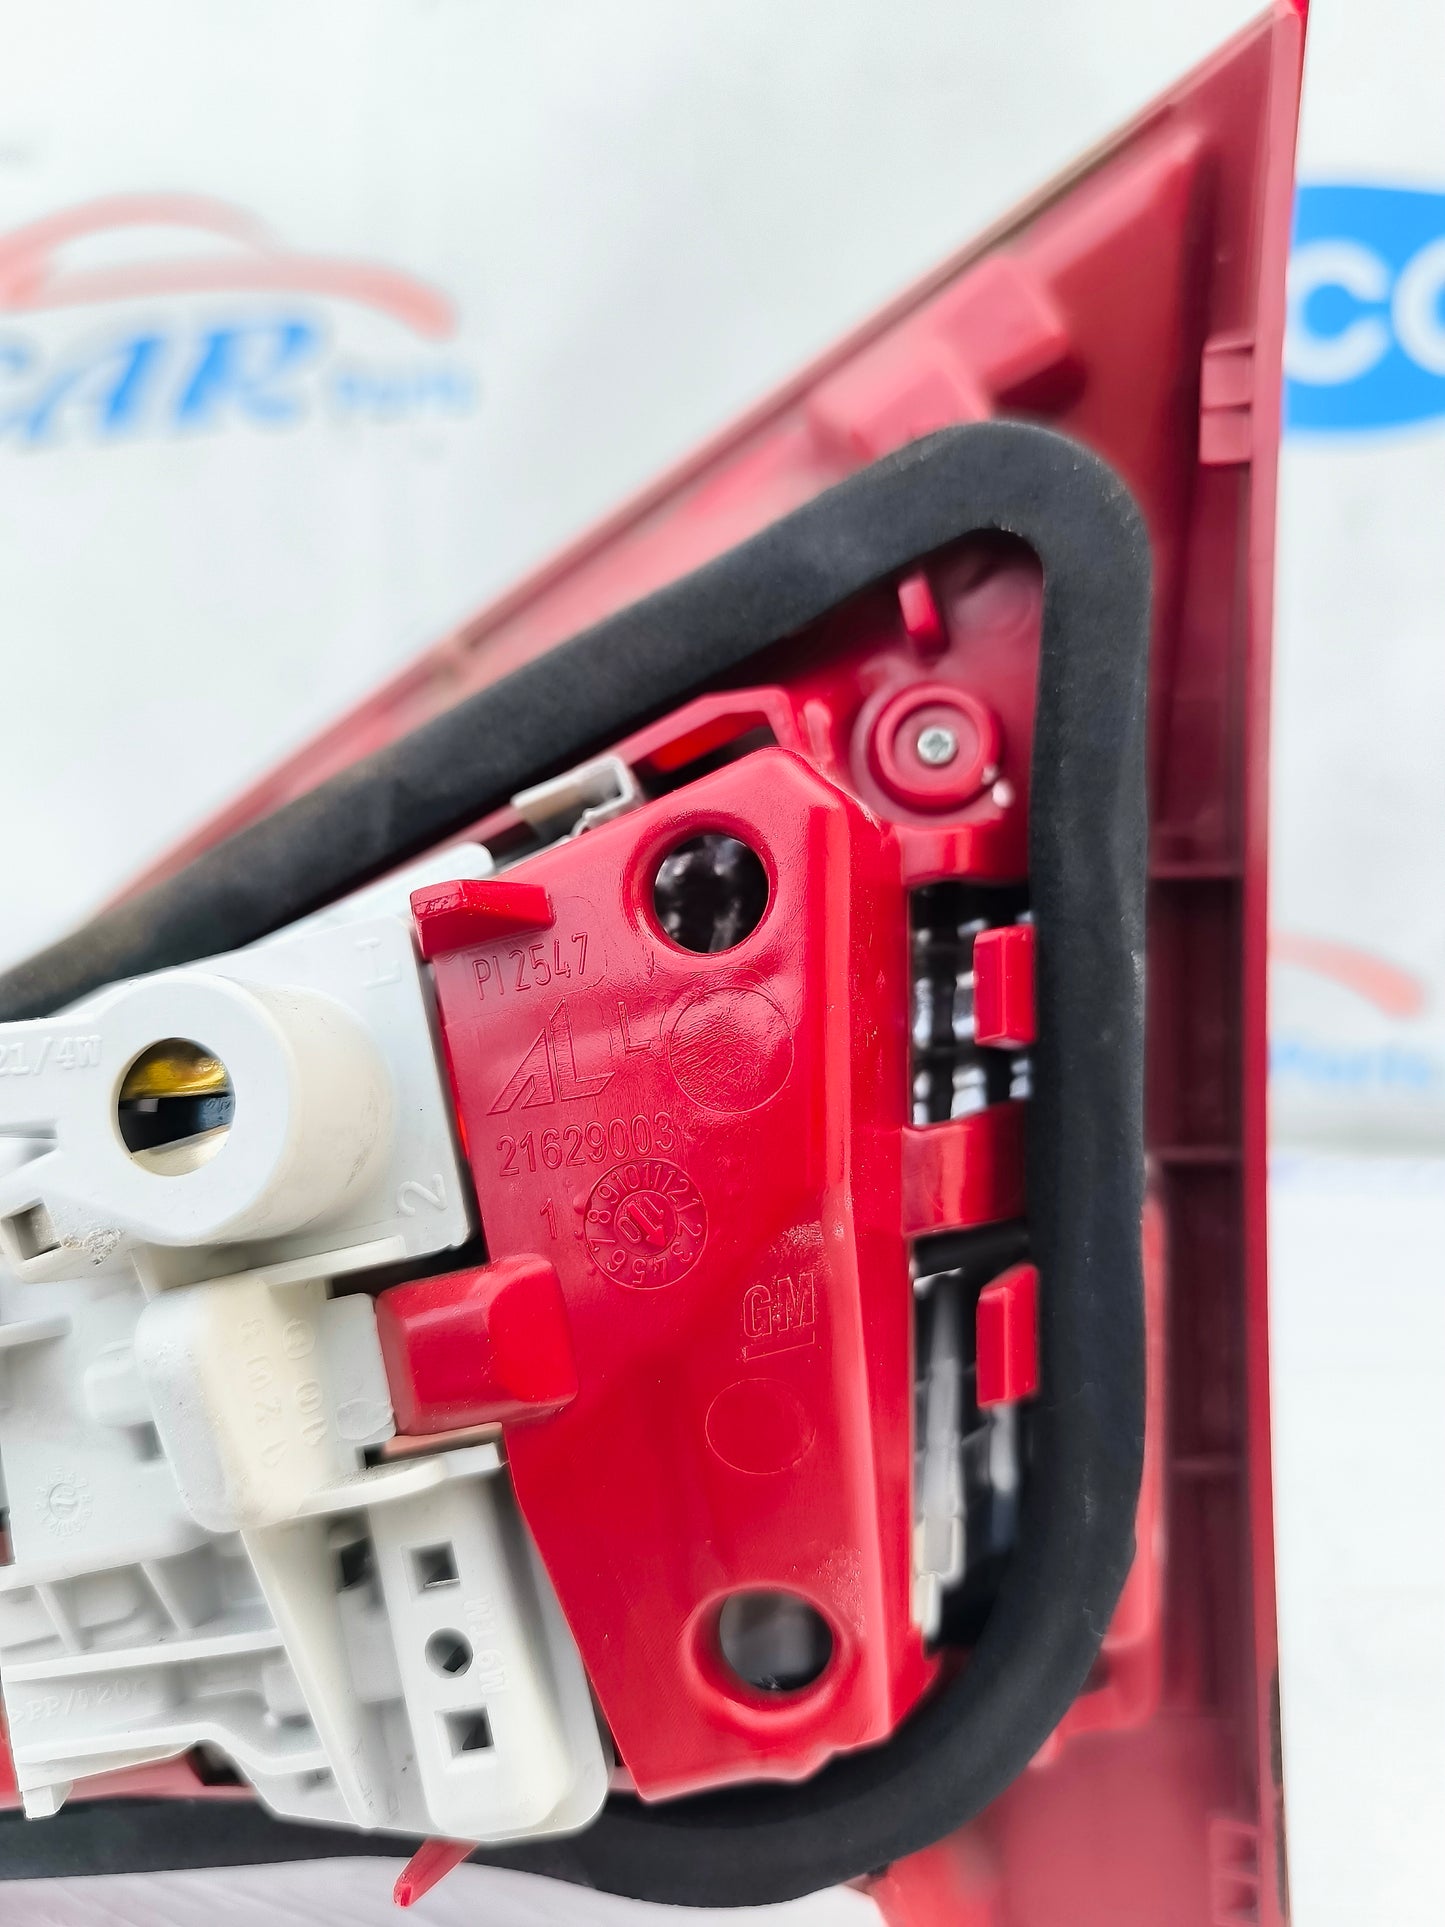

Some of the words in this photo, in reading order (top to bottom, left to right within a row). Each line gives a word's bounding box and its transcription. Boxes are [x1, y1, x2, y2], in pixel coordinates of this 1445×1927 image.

[508, 931, 589, 992] 2547
[496, 1111, 677, 1177] 21629003
[743, 1272, 816, 1338] GM
